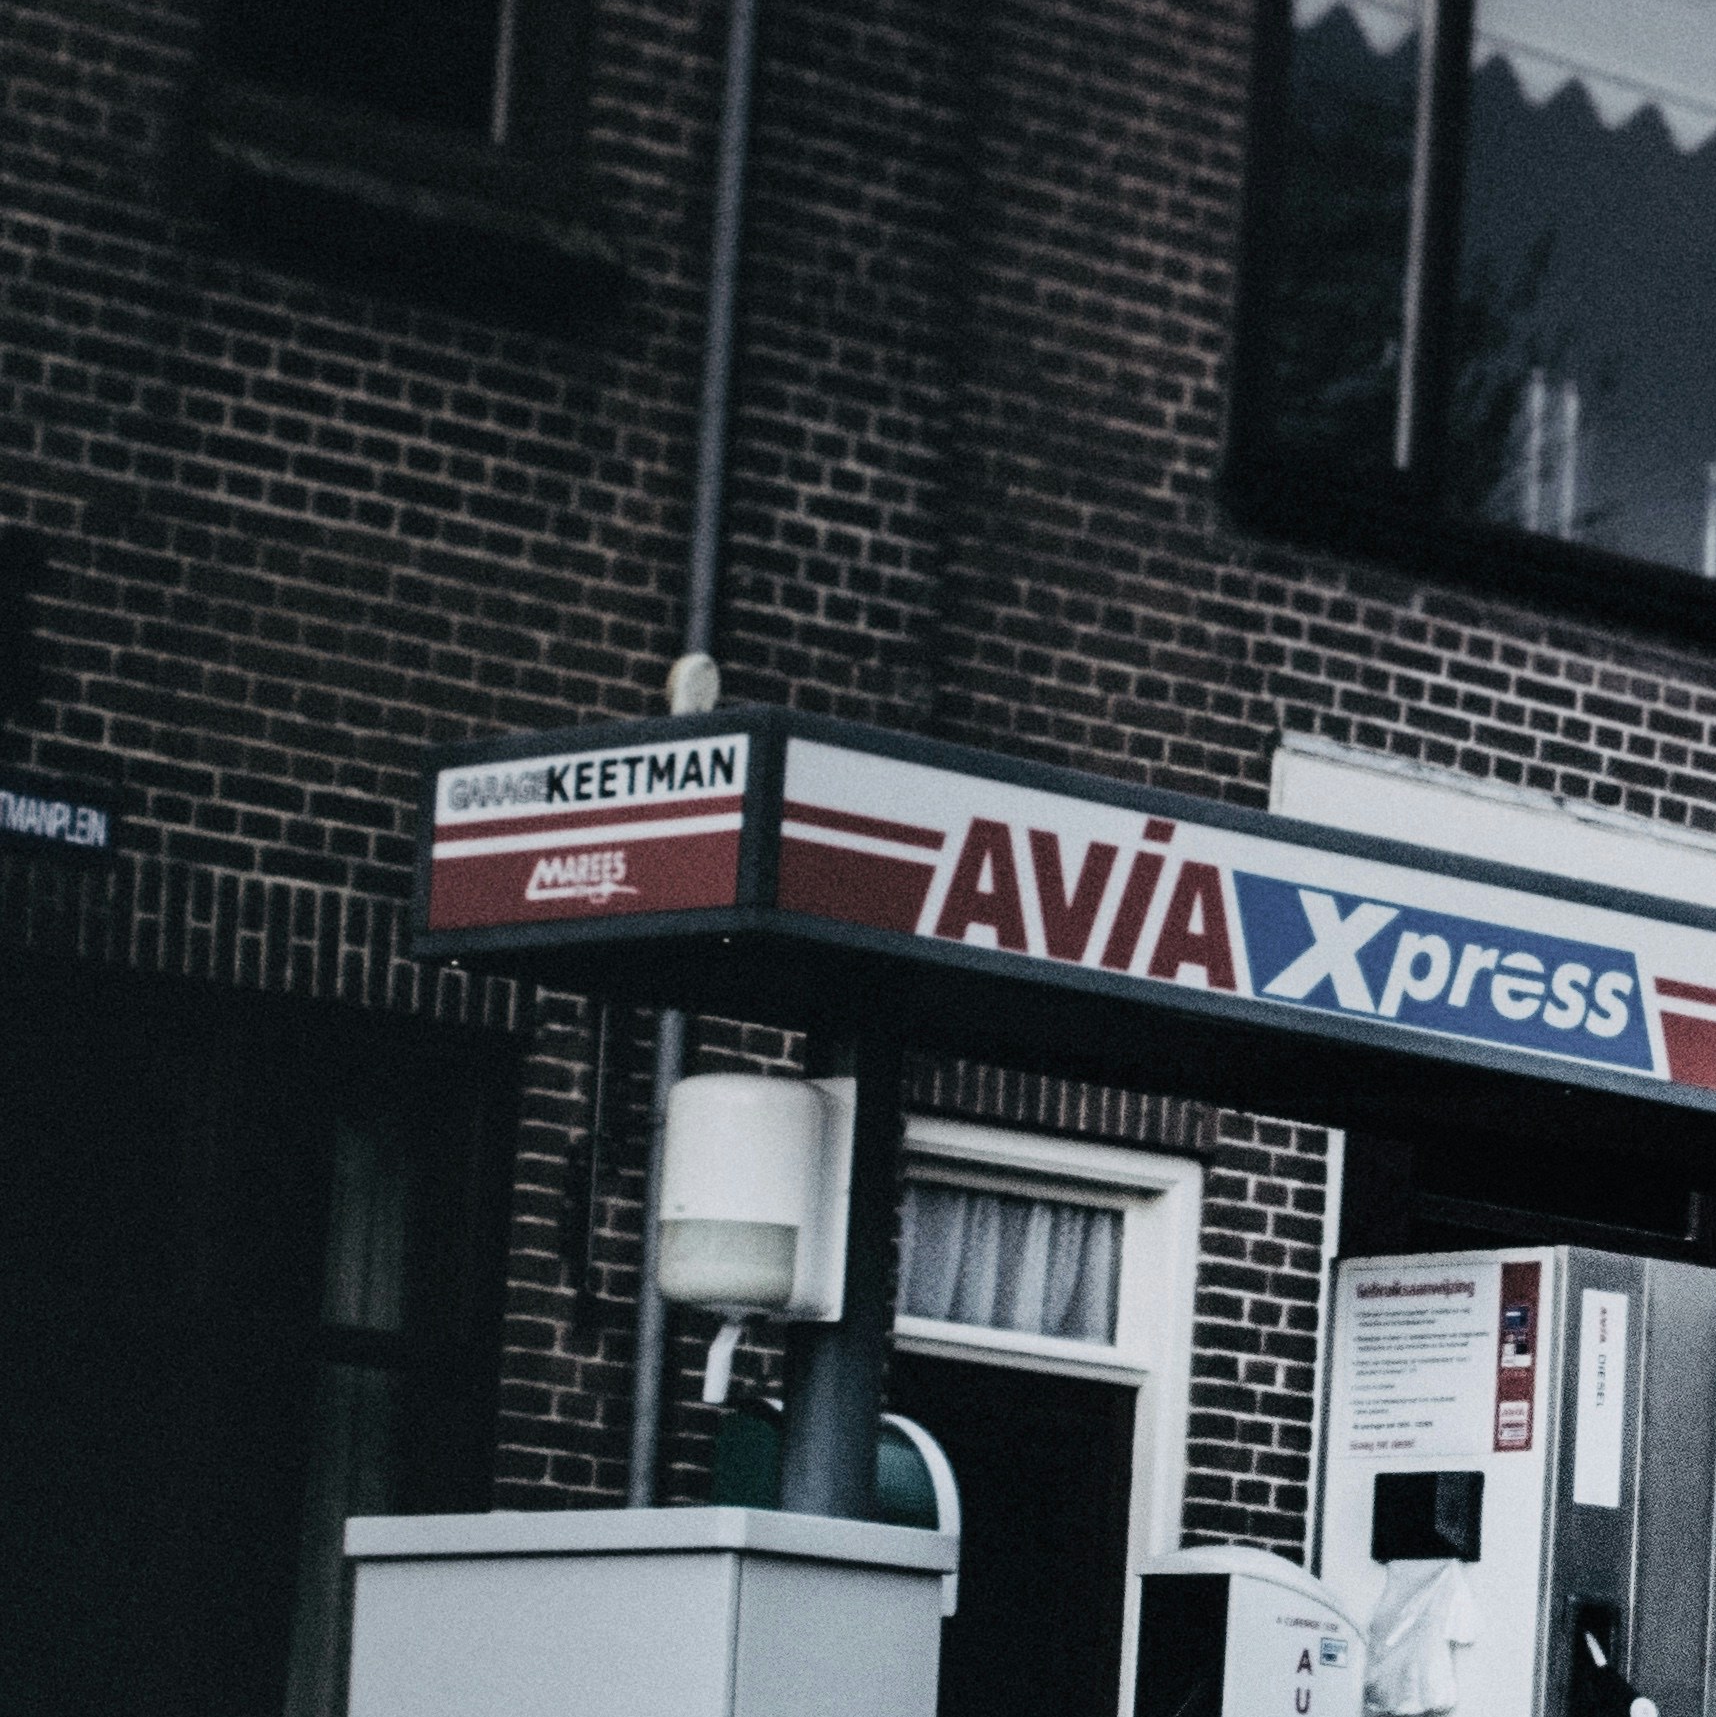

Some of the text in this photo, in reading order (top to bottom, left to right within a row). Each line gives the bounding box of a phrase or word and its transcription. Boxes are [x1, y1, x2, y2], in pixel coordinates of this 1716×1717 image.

[451, 746, 736, 810] GARAGE KEETMAN
[1260, 886, 1636, 1039] Xpress
